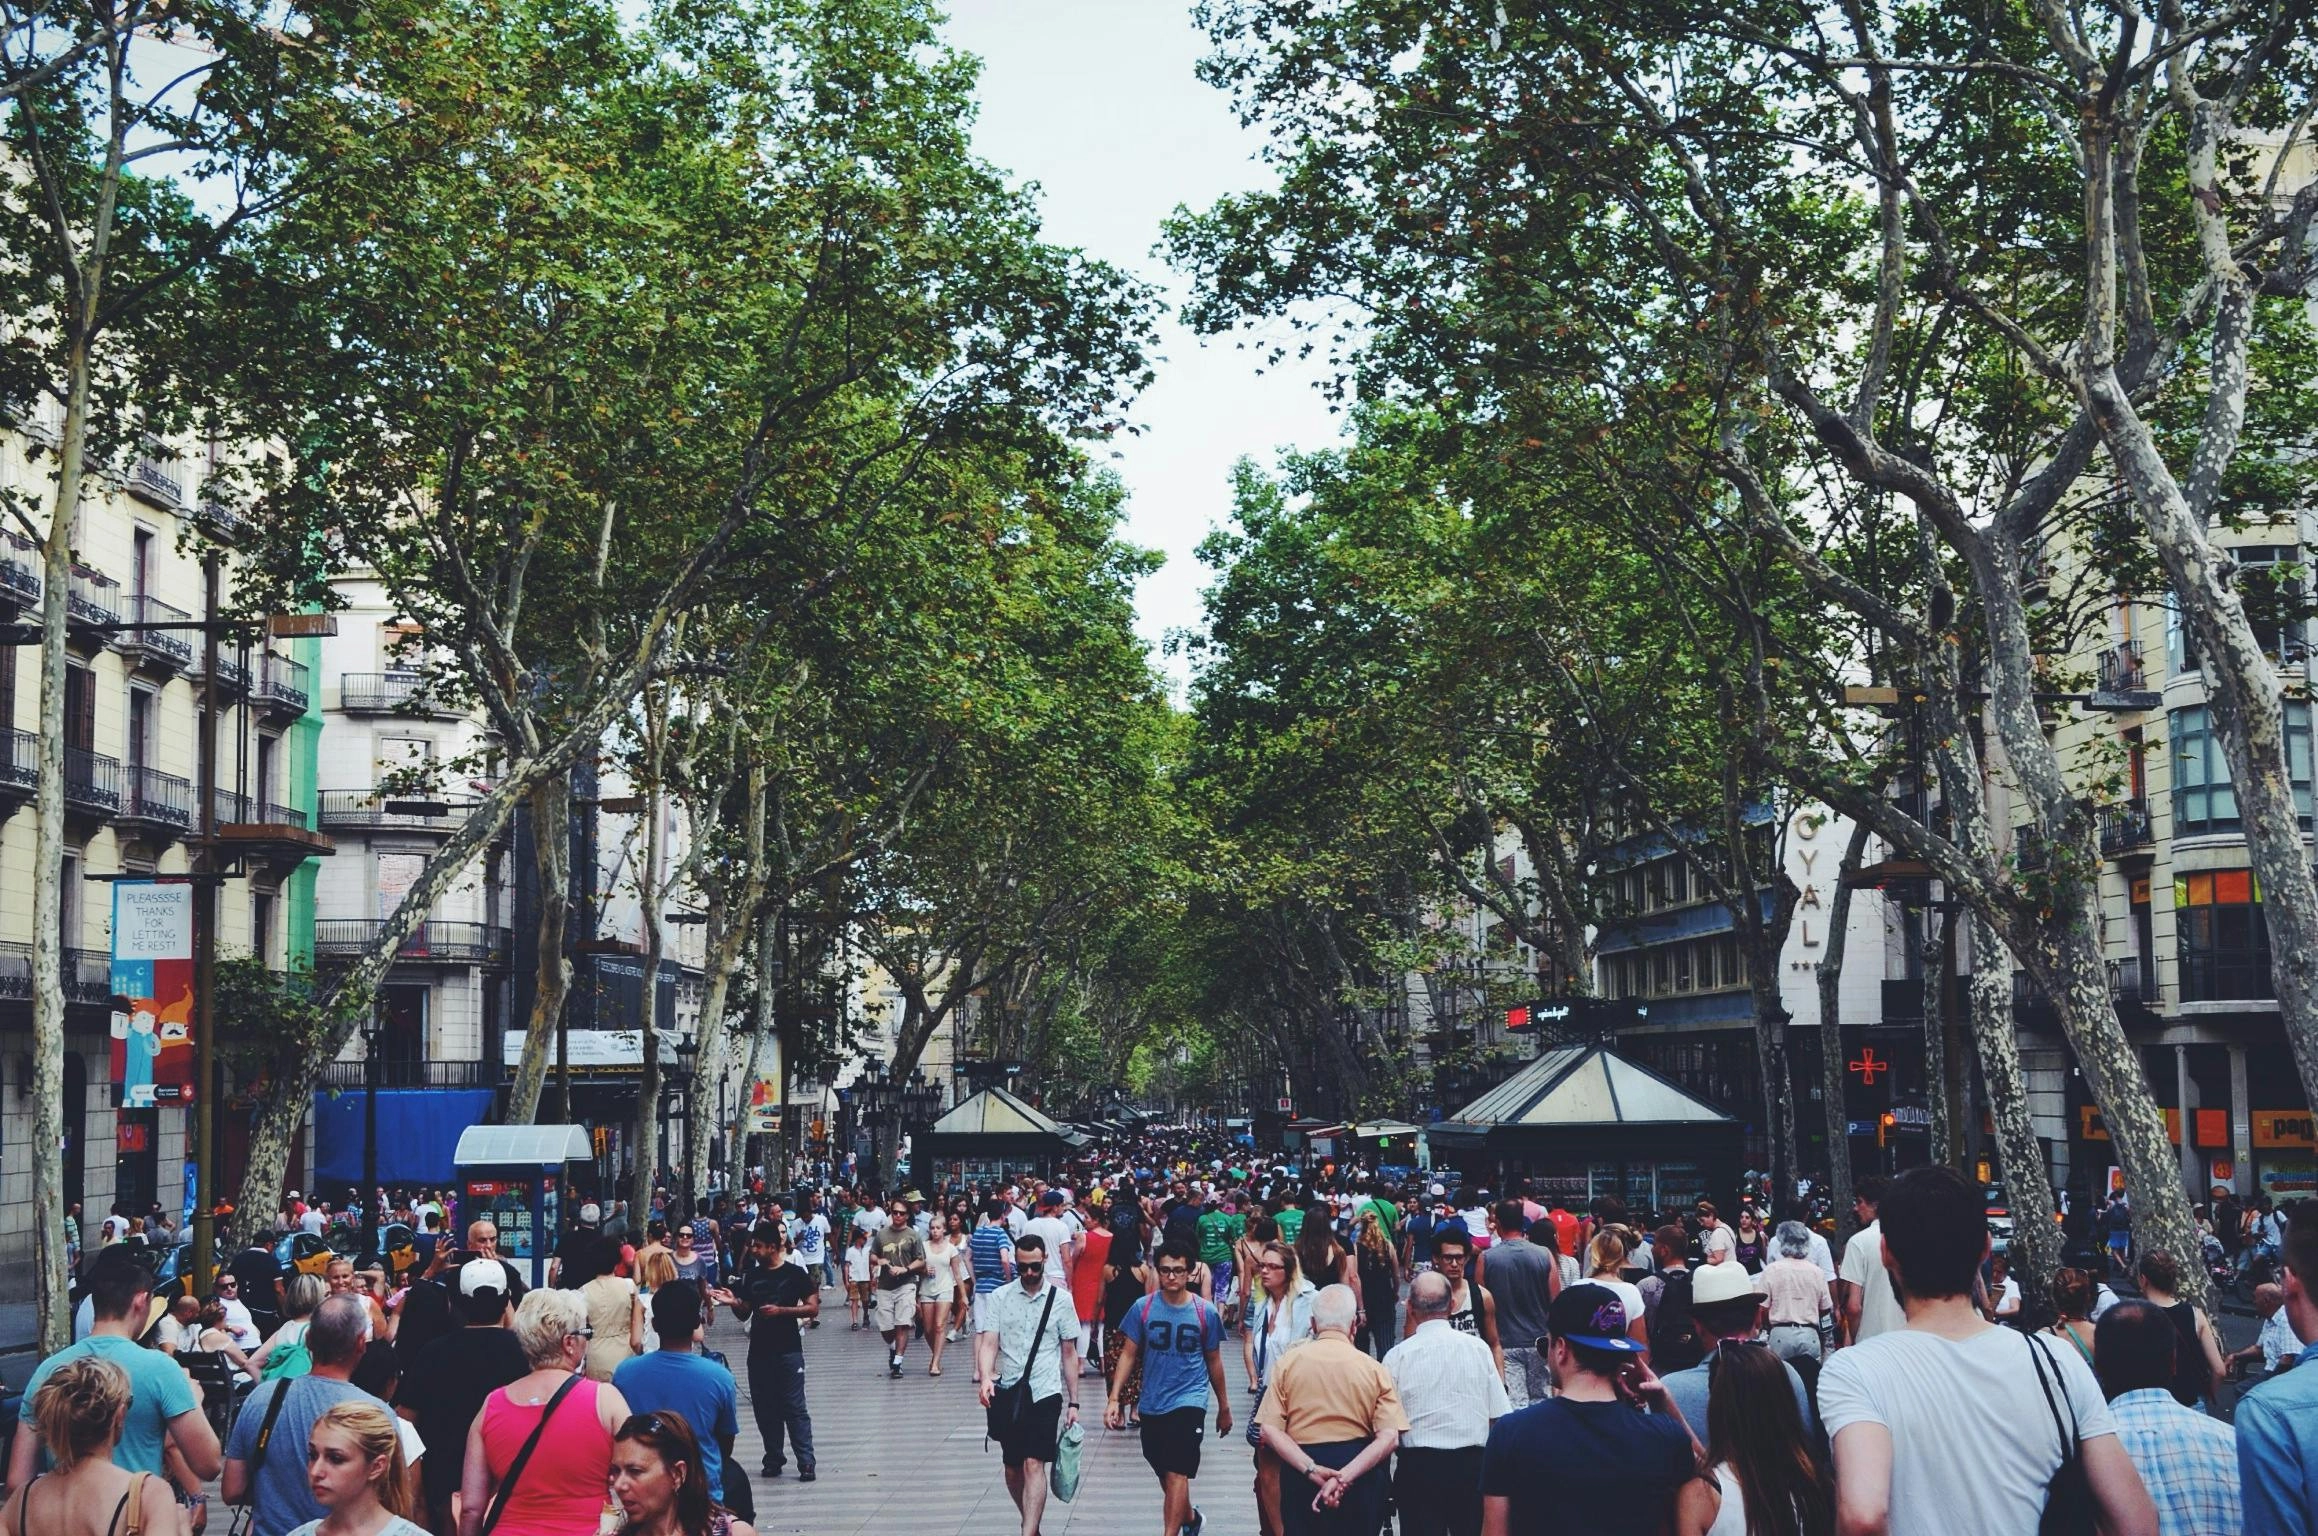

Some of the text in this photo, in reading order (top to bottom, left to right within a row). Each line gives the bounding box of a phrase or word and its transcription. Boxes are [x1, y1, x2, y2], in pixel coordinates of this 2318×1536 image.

[136, 906, 175, 917] THANKS
[144, 918, 164, 929] FOR
[132, 929, 176, 940] LETTING
[132, 941, 145, 951] ME
[1848, 1123, 1857, 1134] P
[1148, 1320, 1200, 1353] 36
